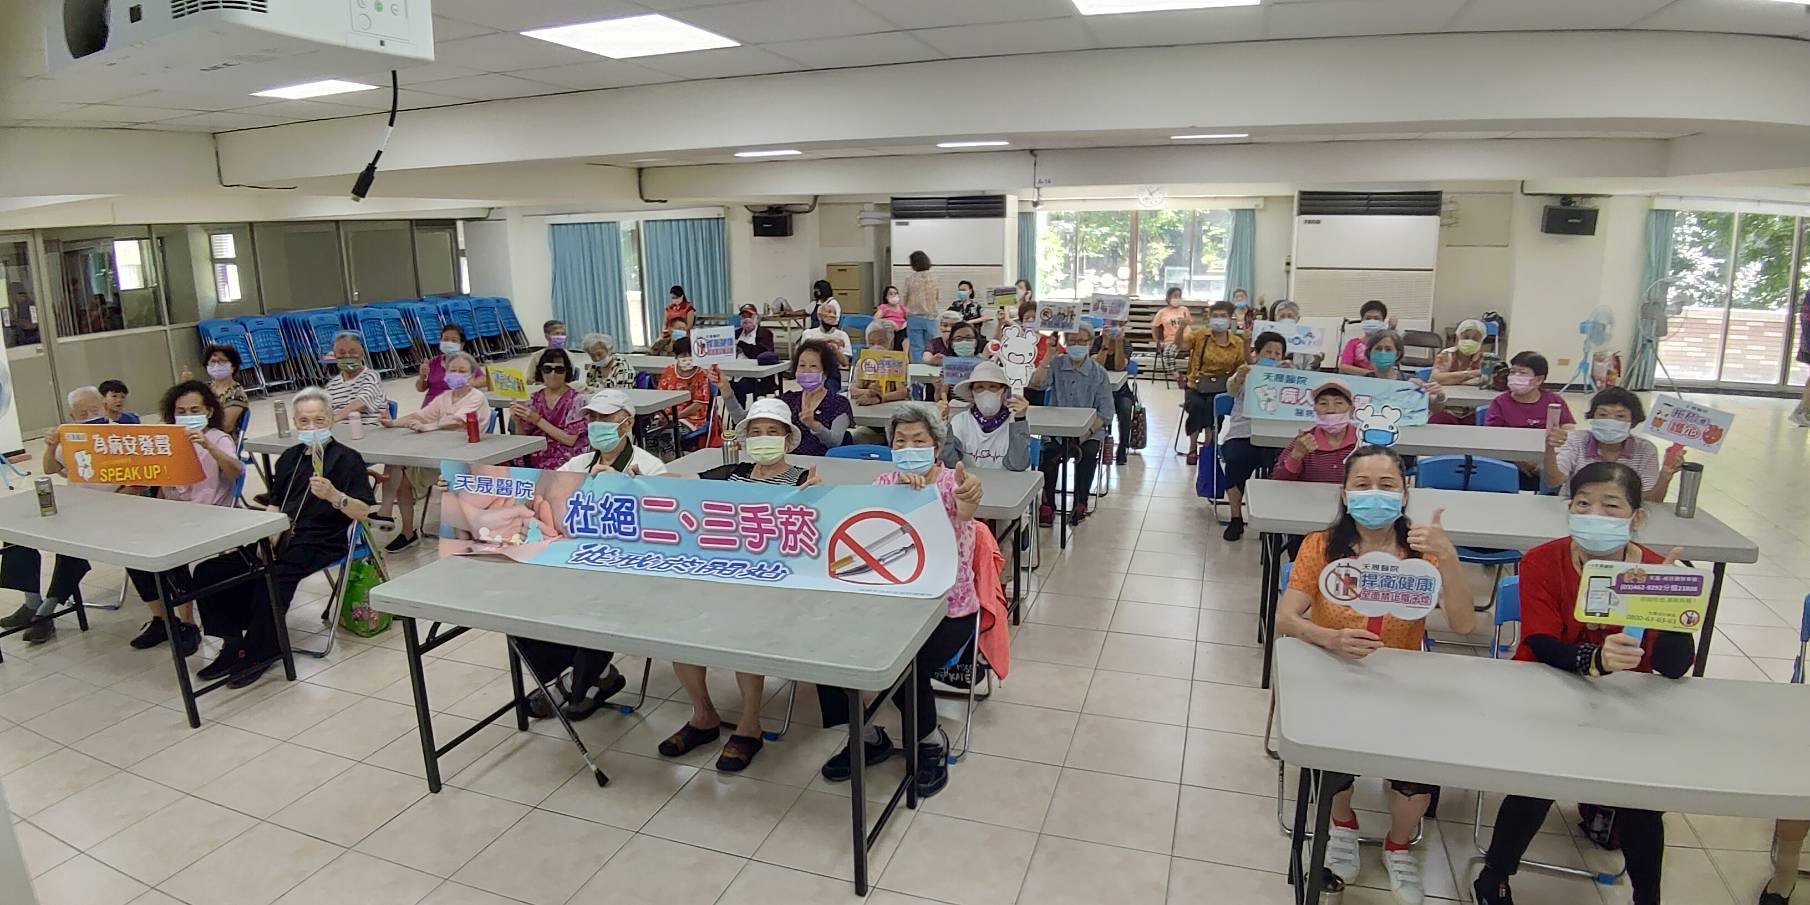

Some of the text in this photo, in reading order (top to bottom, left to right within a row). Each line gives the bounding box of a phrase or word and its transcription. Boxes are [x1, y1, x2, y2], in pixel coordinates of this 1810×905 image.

[92, 433, 173, 457] 為病安發聲
[100, 466, 141, 482] SPEAK
[453, 474, 535, 499] 天晟醫院
[1360, 571, 1435, 593] 捍衛健康
